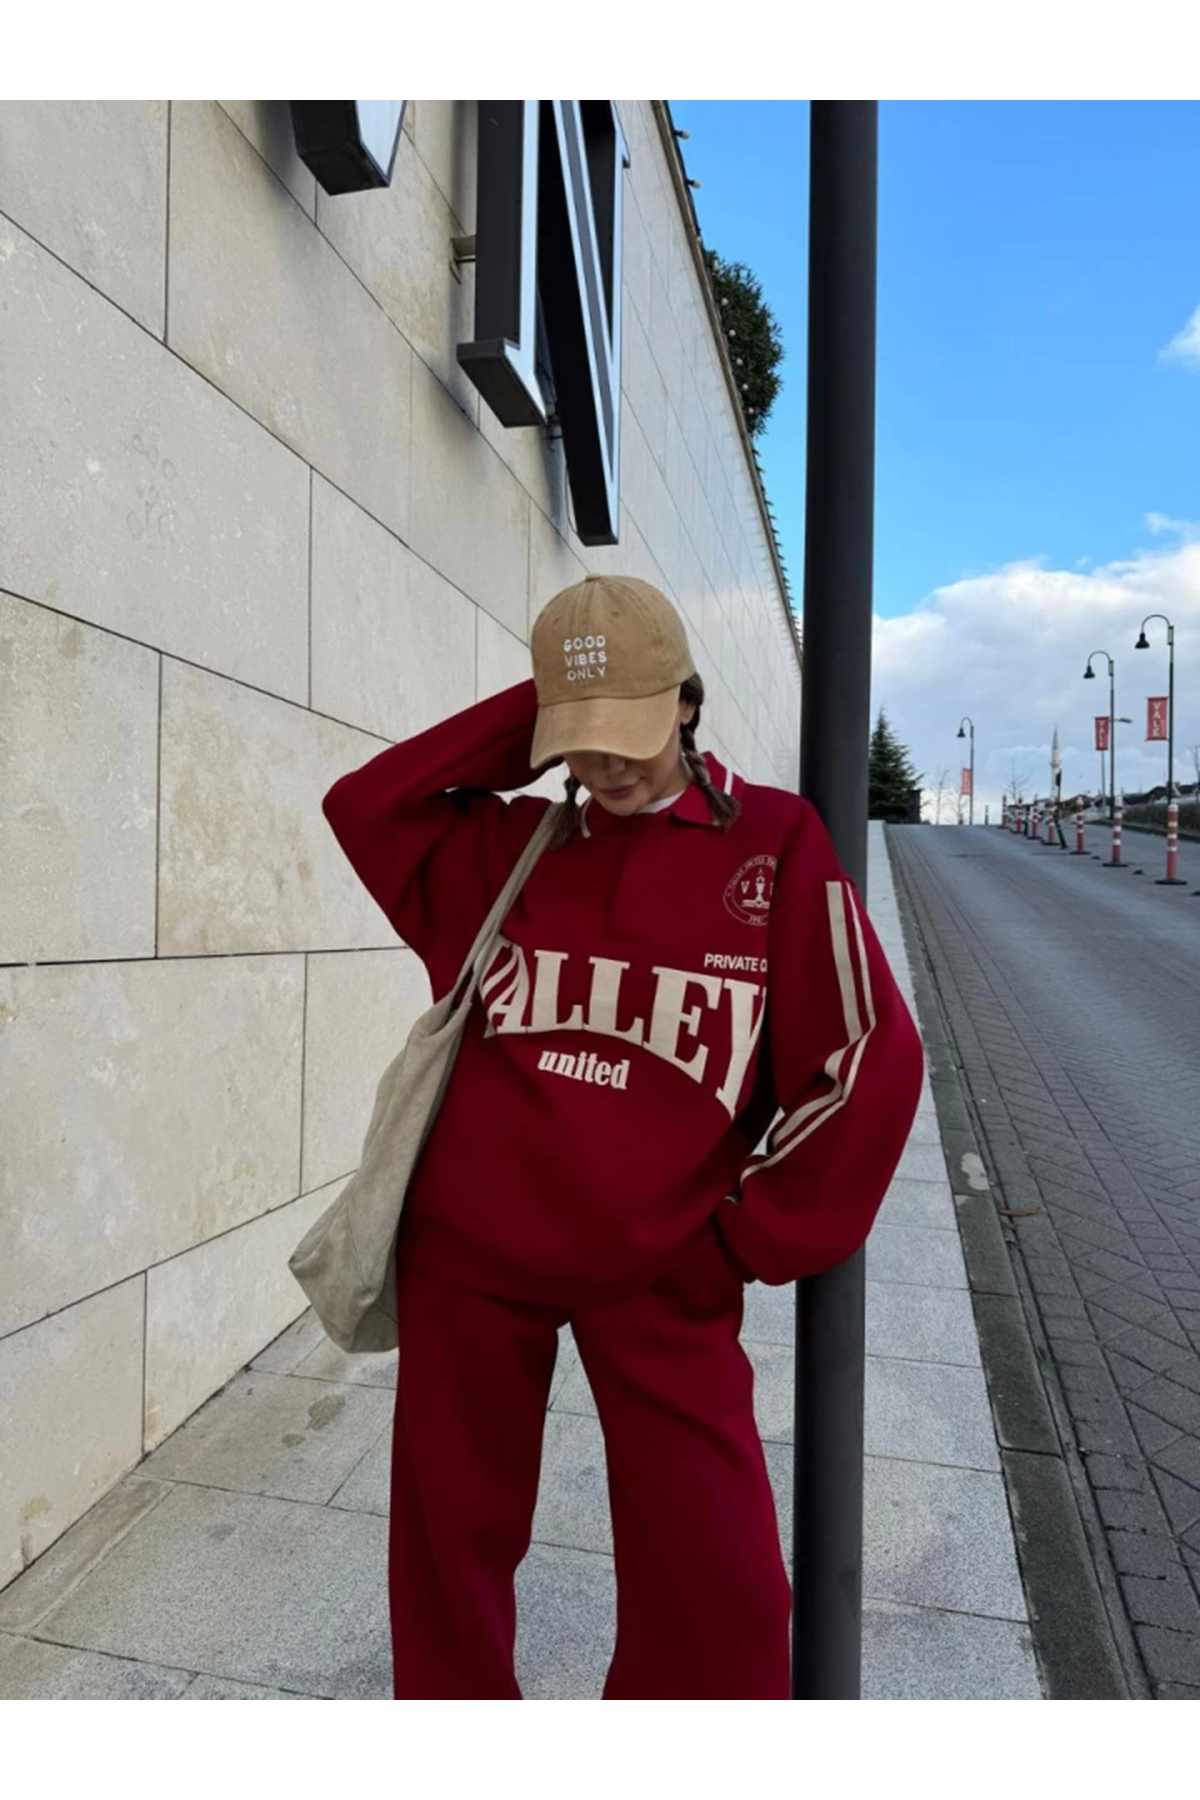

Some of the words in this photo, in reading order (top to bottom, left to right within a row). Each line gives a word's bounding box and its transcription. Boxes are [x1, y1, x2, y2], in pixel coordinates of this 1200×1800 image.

[563, 634, 606, 652] GOOD
[564, 650, 608, 668] VIBES
[567, 665, 606, 681] ONLY
[703, 952, 760, 973] PRIVATE
[537, 1050, 630, 1090] united
